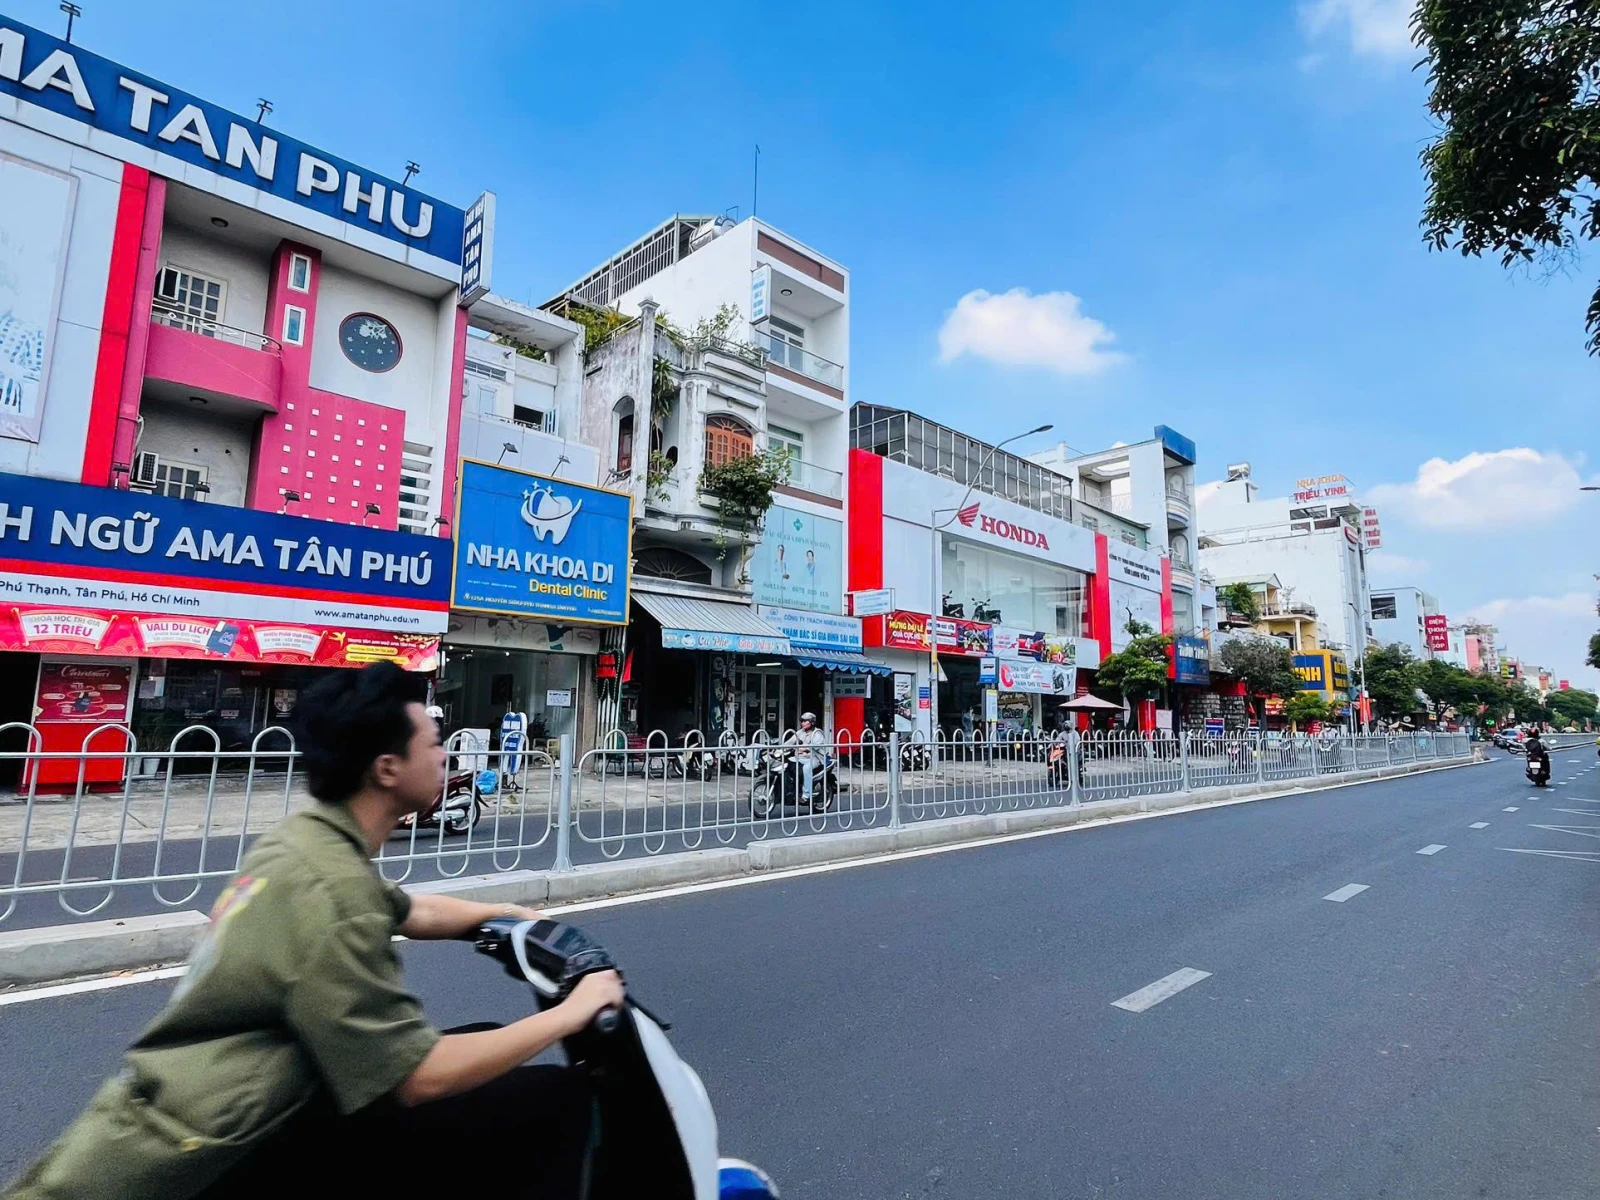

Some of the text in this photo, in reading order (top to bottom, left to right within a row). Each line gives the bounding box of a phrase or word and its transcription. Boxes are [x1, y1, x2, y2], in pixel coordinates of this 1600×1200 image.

[119, 76, 279, 181] TAN
[297, 151, 434, 238] PHU
[1296, 478, 1316, 488] NHA
[1324, 485, 1347, 496] VINH
[980, 514, 1050, 551] HONDA
[50, 511, 160, 554] NGỮ
[166, 526, 264, 568] AMA
[273, 536, 352, 577] TÂN
[361, 551, 433, 587] PHÚ
[466, 542, 614, 584] NHA KHOA DI
[27, 583, 71, 597] Thạnh,
[75, 586, 97, 598] Tân
[101, 589, 128, 602] Phú,
[151, 593, 170, 604] Chí
[172, 596, 200, 607] Minh
[529, 578, 572, 597] Dental
[573, 583, 608, 601] Clinic
[146, 622, 168, 632] VALI
[172, 622, 187, 632] DU
[314, 607, 420, 625] www.amatanphu.edu.vn
[33, 623, 50, 635] 12
